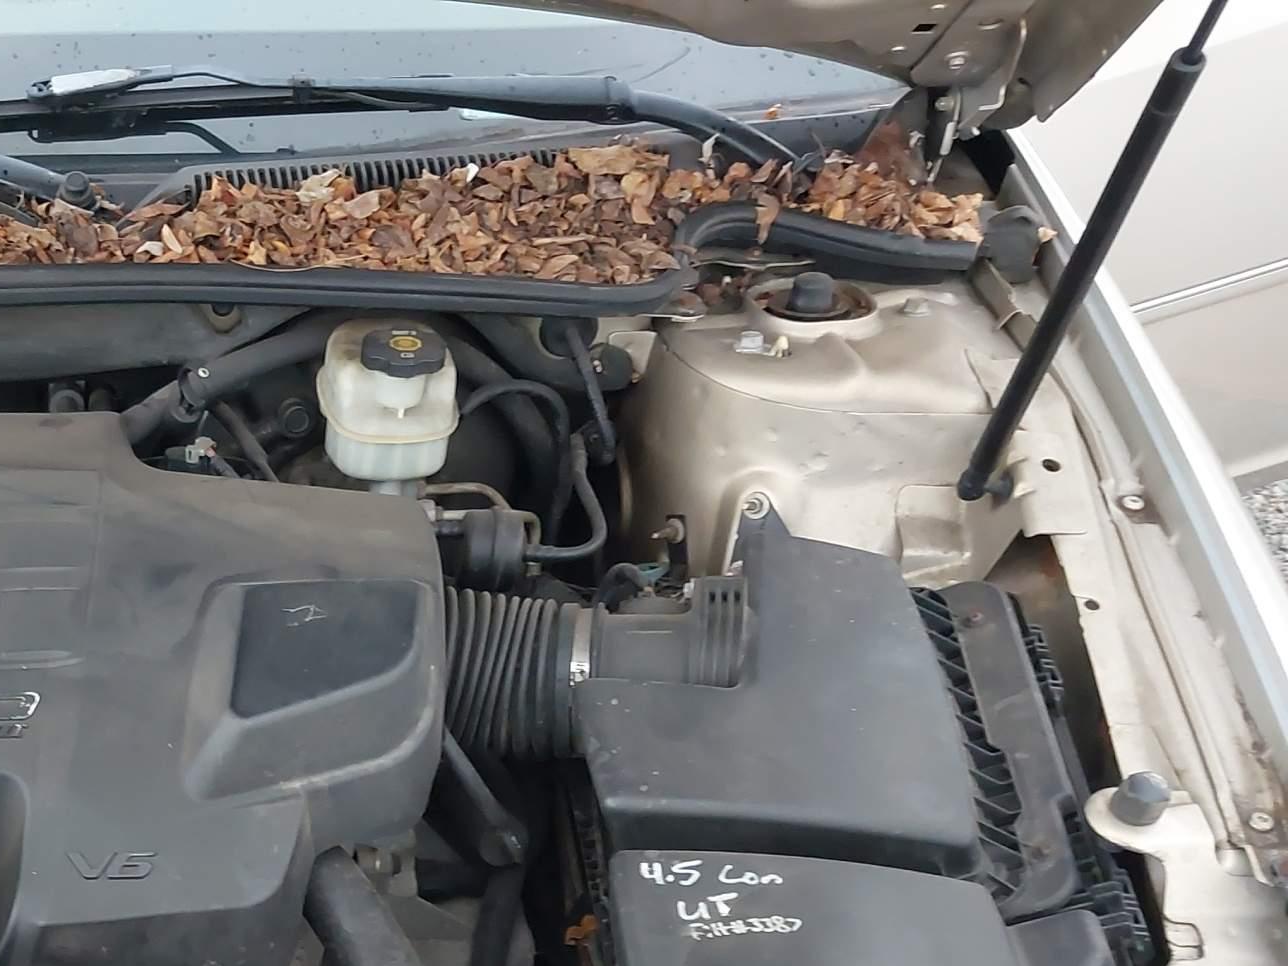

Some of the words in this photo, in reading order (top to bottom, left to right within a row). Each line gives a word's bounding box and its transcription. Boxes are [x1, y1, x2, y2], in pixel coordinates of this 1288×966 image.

[65, 850, 159, 881] V6
[639, 859, 703, 886] 4.5
[676, 891, 739, 921] UT
